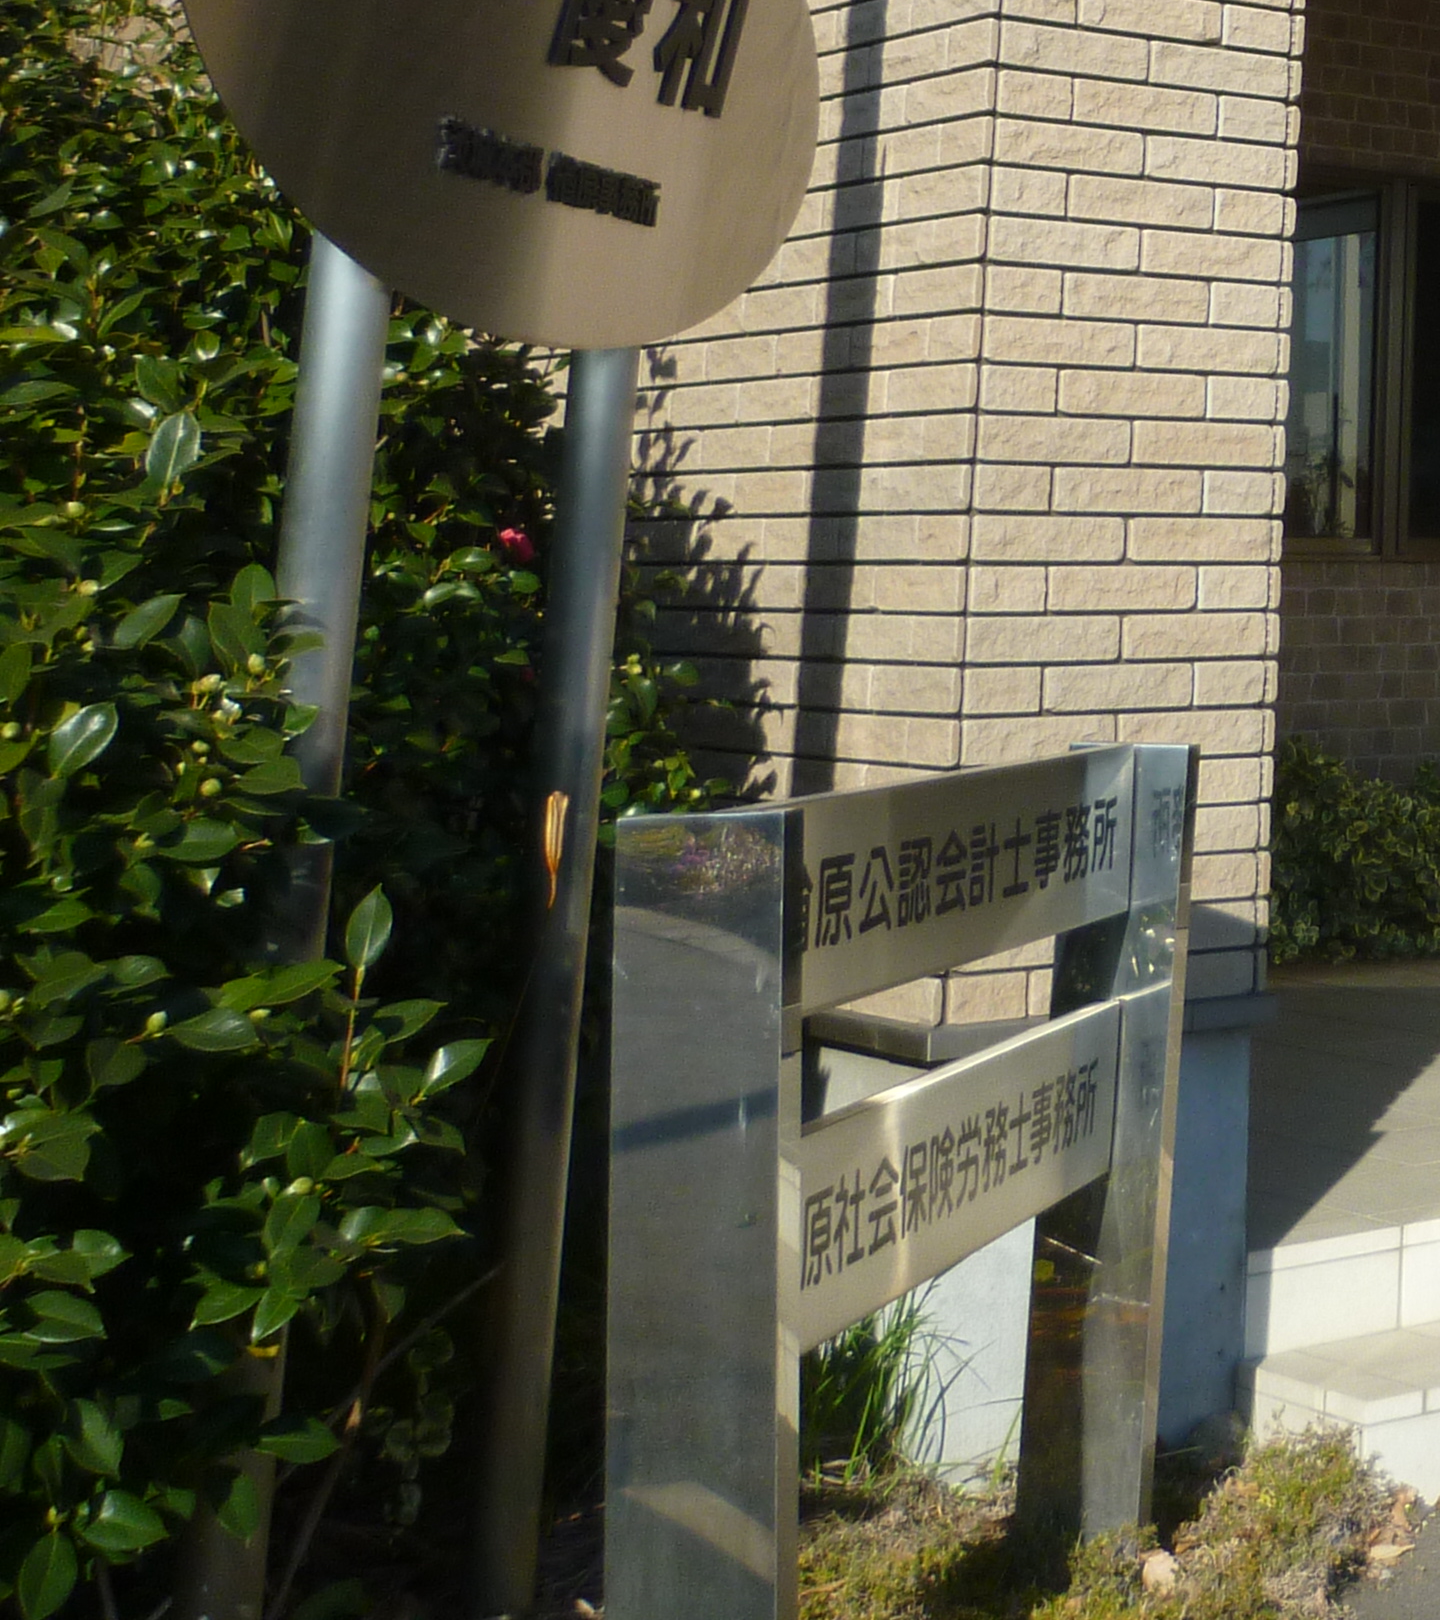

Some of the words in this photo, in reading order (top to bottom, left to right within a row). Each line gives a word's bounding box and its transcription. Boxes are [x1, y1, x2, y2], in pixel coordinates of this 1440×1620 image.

[801, 795, 1119, 954] 原公認会計士事務所
